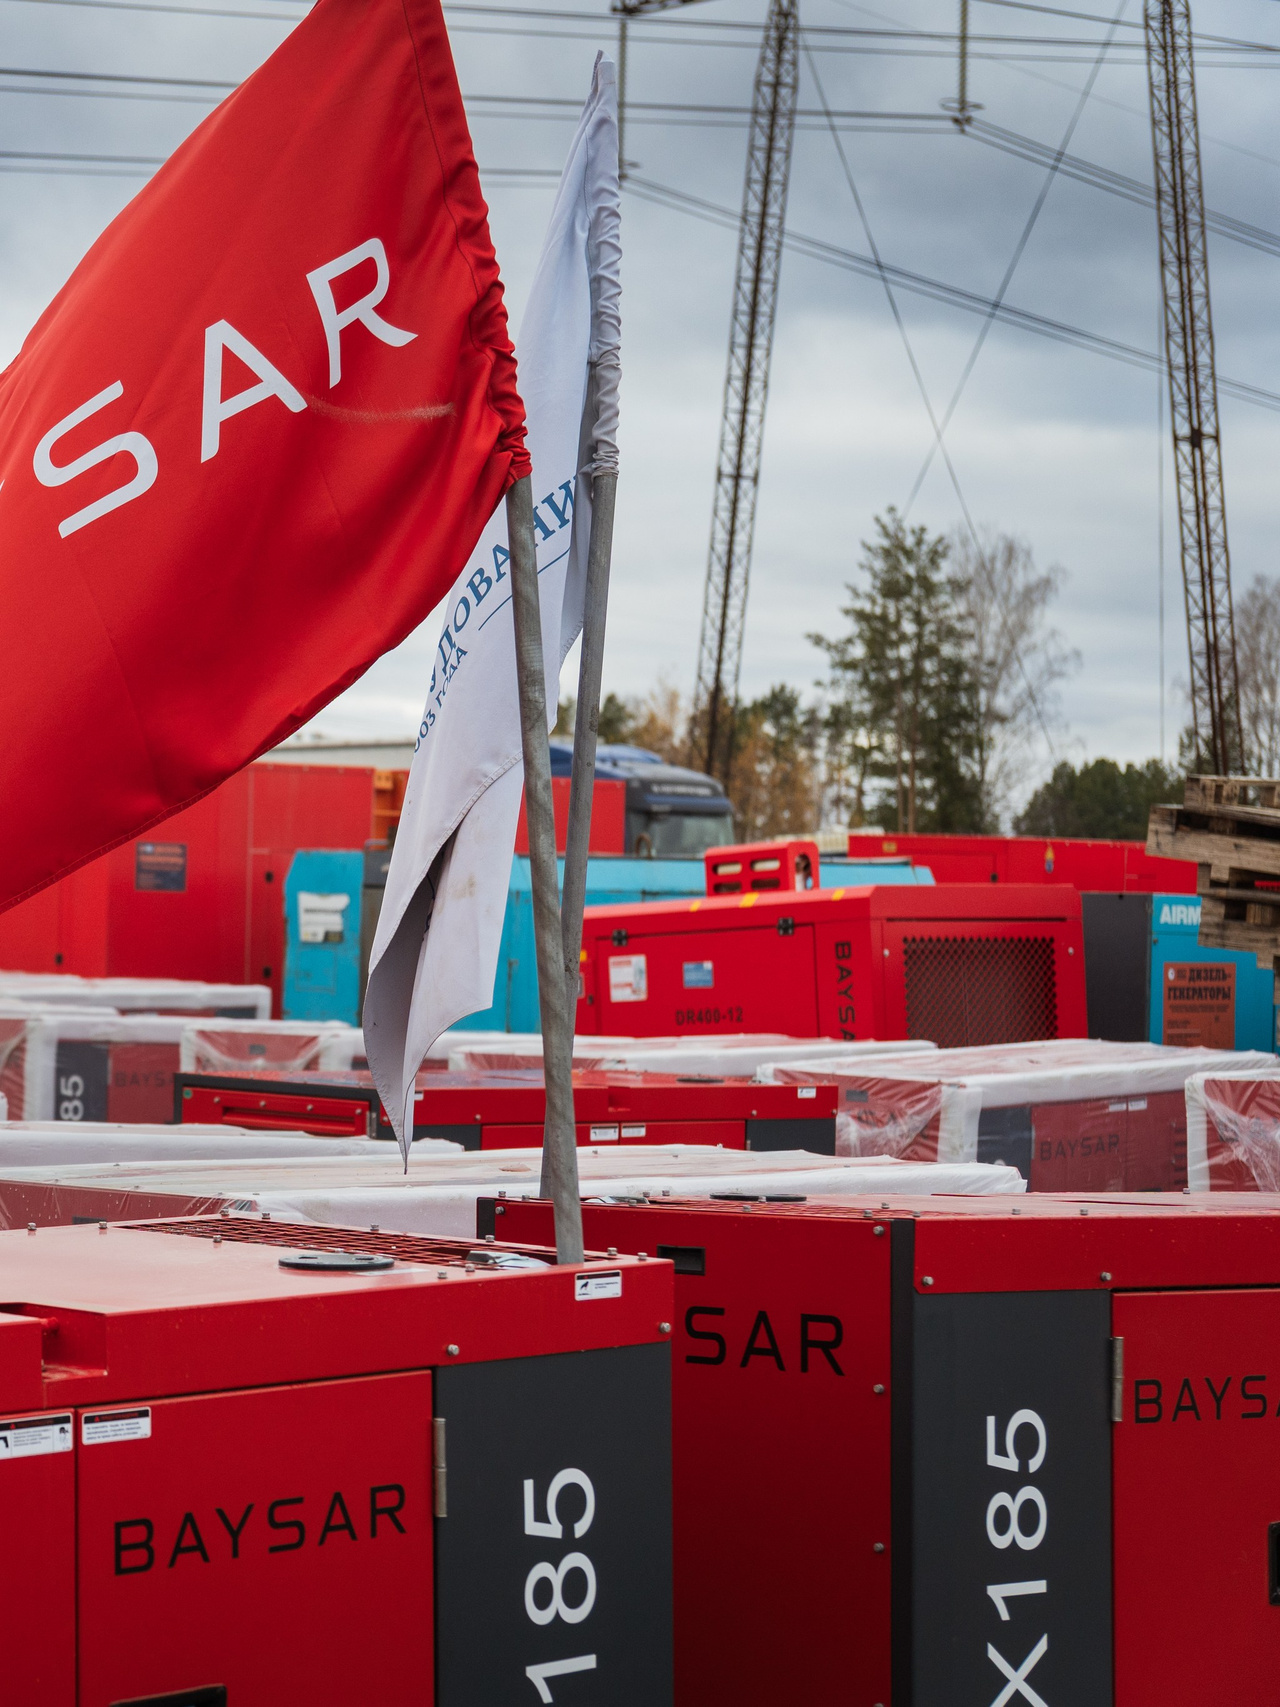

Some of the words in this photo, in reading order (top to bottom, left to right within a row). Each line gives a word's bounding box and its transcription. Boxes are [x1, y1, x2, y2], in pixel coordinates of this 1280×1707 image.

[1167, 986, 1231, 1000] ГЕНЕРАТОРЫ
[1039, 1134, 1121, 1162] BAYSAR
[684, 1305, 846, 1377] SAR
[1134, 1374, 1280, 1424] BAYS
[114, 1482, 408, 1576] BAYSAR
[523, 1467, 597, 1704] 185
